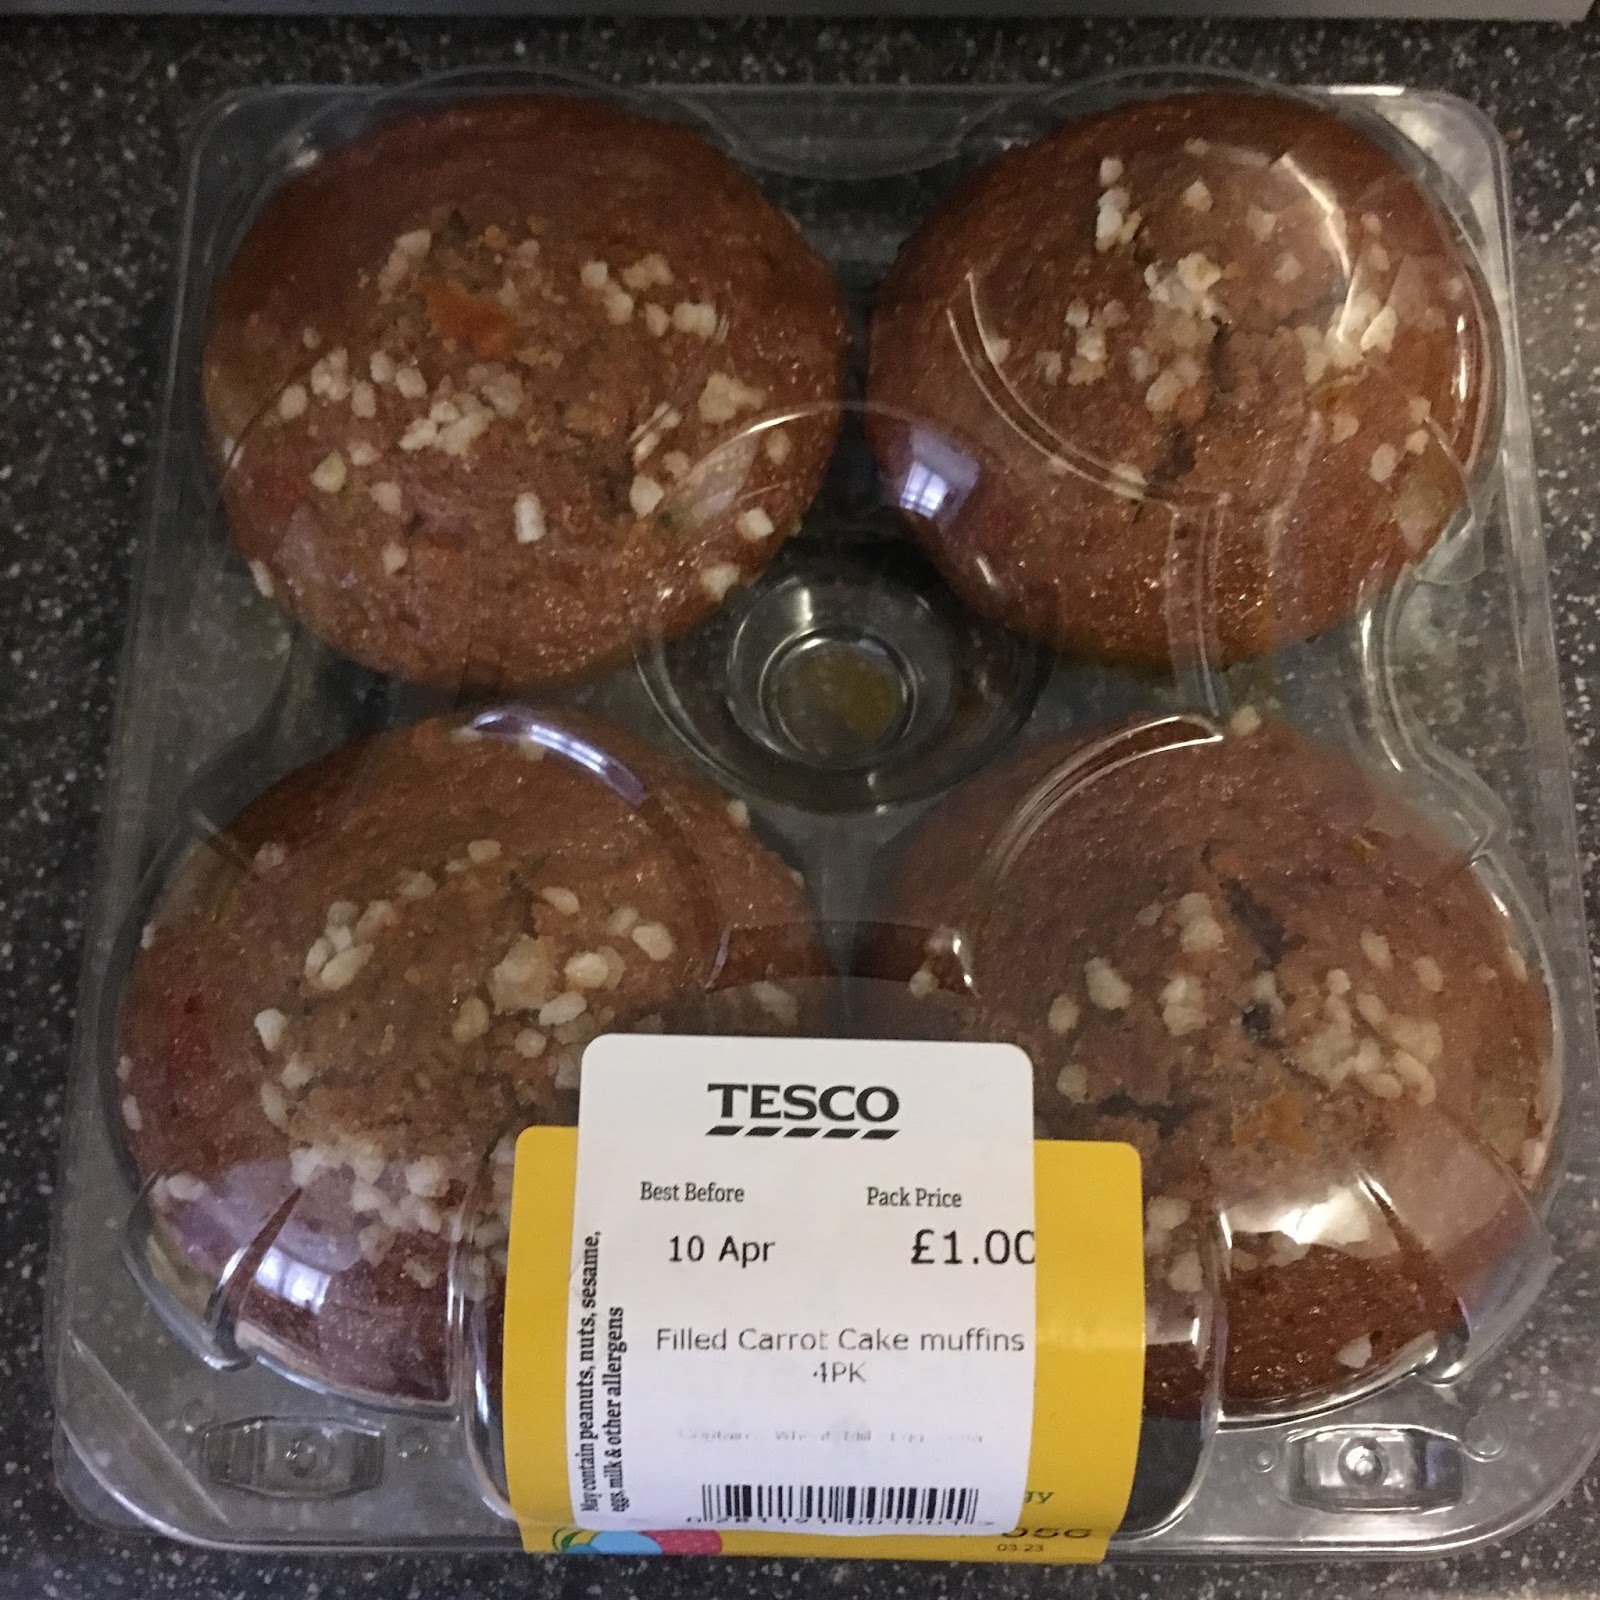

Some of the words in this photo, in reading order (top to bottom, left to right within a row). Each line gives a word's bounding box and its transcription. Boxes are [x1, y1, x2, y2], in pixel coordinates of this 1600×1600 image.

[707, 1083, 900, 1122] TESCO
[640, 1181, 680, 1202] Best
[684, 1182, 745, 1203] Before
[866, 1187, 910, 1206] Pack
[915, 1188, 962, 1208] Price
[668, 1235, 704, 1262] 10
[718, 1235, 776, 1268] Apr
[910, 1229, 1036, 1265] £1.00
[581, 1230, 602, 1309] sesame,
[577, 1312, 598, 1362] nuts,
[601, 1306, 627, 1397] allergens
[656, 1327, 727, 1351] Filled
[737, 1327, 828, 1352] Carrot
[837, 1328, 909, 1352] Cake
[919, 1327, 1026, 1353] muffins
[576, 1365, 599, 1440] peanuts,
[602, 1399, 622, 1445] other
[575, 1442, 597, 1491] contain
[604, 1448, 622, 1458] &
[603, 1461, 623, 1488] milk
